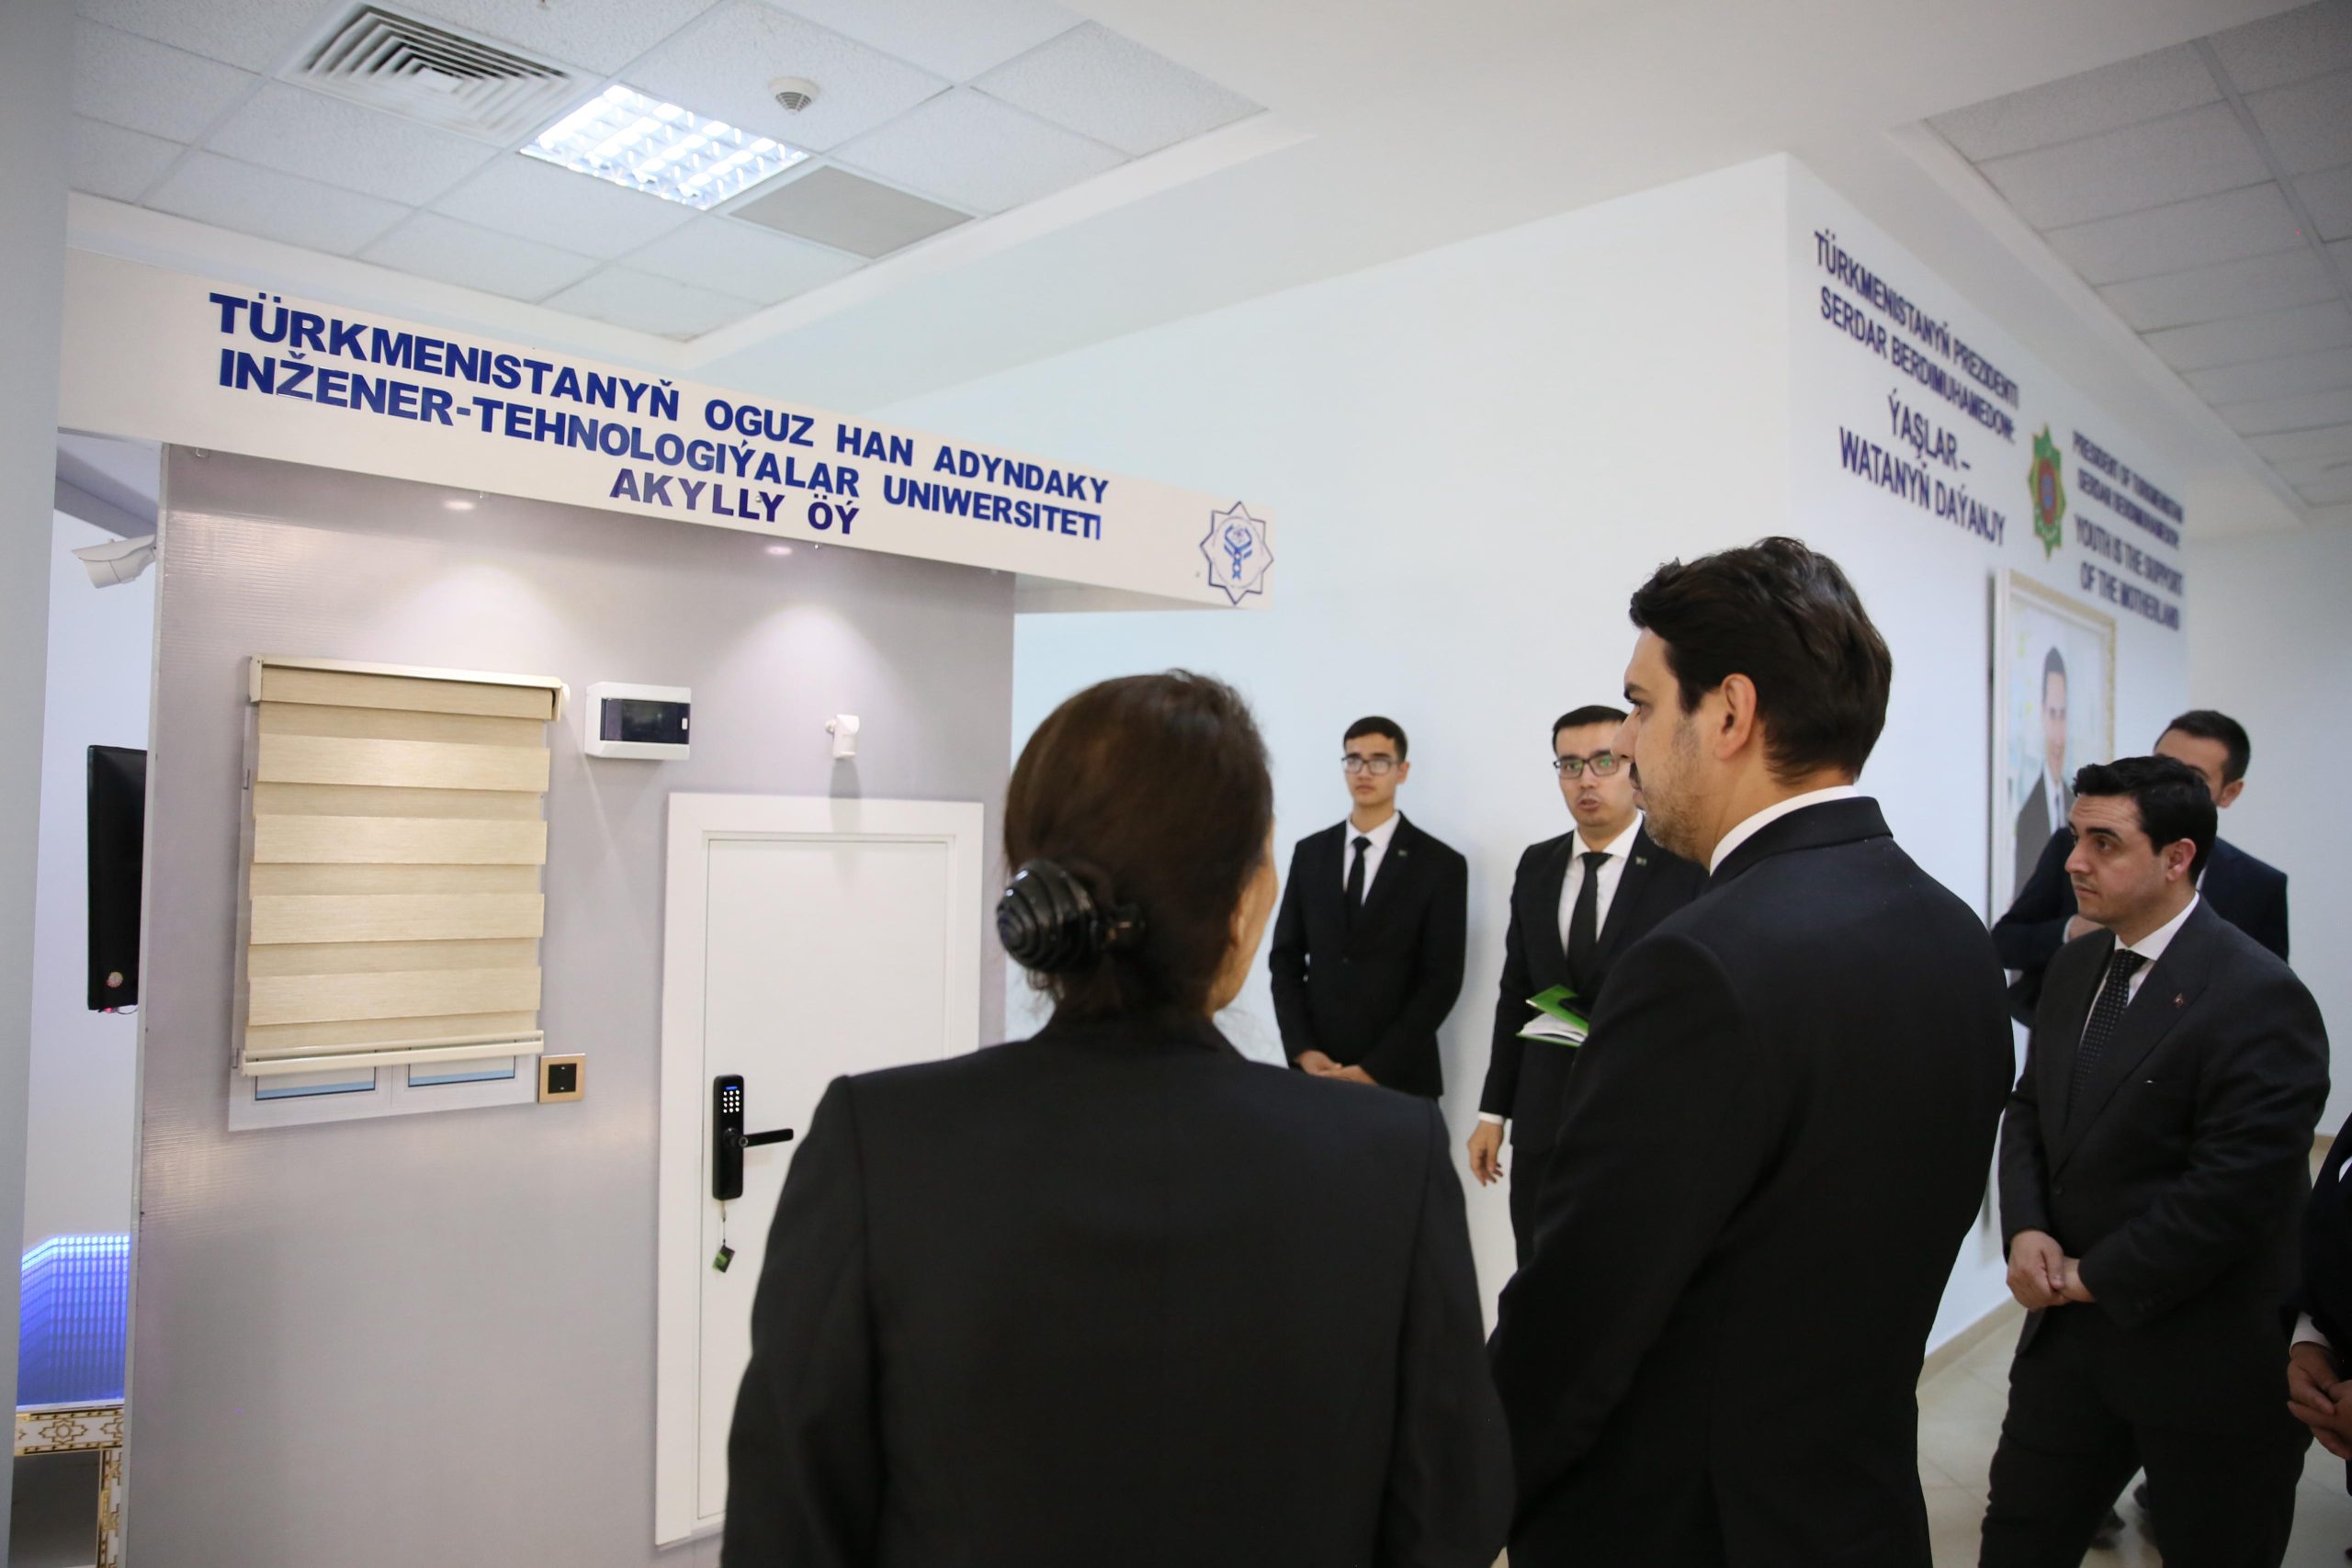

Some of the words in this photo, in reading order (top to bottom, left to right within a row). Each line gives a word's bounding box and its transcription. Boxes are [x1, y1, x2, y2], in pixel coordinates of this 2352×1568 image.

[1814, 229, 1951, 360] TÜRKMENISTANYŇ
[1820, 285, 1888, 360] SERDAR
[209, 292, 679, 422] TÜRKMENISTANYŇ
[704, 399, 815, 447] OGUZ
[836, 423, 914, 467] HAN
[933, 446, 1109, 504] ADYNDAKY
[220, 349, 860, 499] INŽENER-TEHNOLOGIÝALAR
[883, 474, 1101, 540] UNIWERSITETI
[609, 468, 786, 523] AKYLLY
[808, 493, 860, 535] ÖÝ
[1839, 425, 1930, 510] WATANYŇ
[1935, 483, 2006, 547] DAÝANJY
